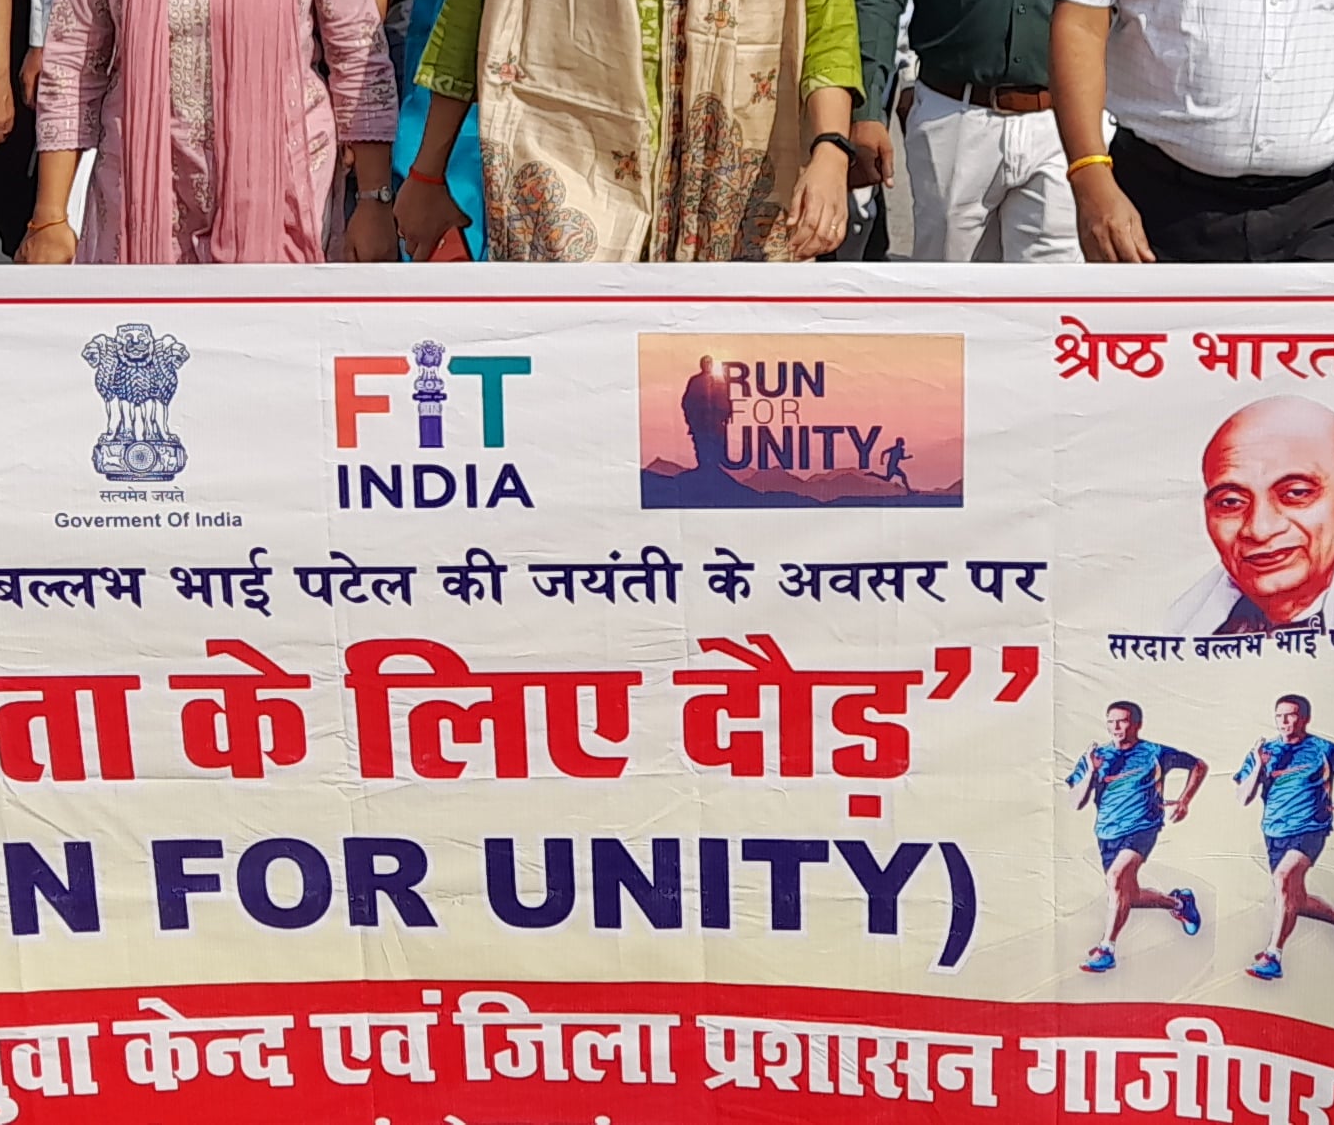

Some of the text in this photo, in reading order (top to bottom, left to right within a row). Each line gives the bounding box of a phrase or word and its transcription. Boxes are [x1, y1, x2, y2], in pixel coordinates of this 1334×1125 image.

[1056, 317, 1167, 379] श्रेष्ठ
[722, 362, 824, 397] RUN
[730, 399, 800, 424] FOR
[720, 426, 882, 469] UNITY
[99, 486, 184, 502] सत्यमेव जयते
[338, 464, 534, 508] INDIA
[54, 512, 242, 527] Goverment Of India
[170, 547, 272, 617] भाई
[293, 551, 417, 606] पटेल
[437, 548, 507, 605] की
[528, 546, 683, 604] जयंती
[703, 547, 754, 604] के
[779, 561, 948, 602] अवसर
[966, 561, 1047, 602] पर
[1108, 634, 1185, 661] सरदार
[1194, 633, 1266, 660] बल्लभ
[1275, 616, 1323, 659] भाई
[169, 640, 310, 779] के
[345, 639, 638, 780] लिए
[152, 837, 438, 930] FOR
[484, 838, 976, 967] UNITY)
[311, 991, 435, 1083] एवं
[453, 992, 680, 1083] जिला
[696, 1014, 998, 1106] प्रशासन
